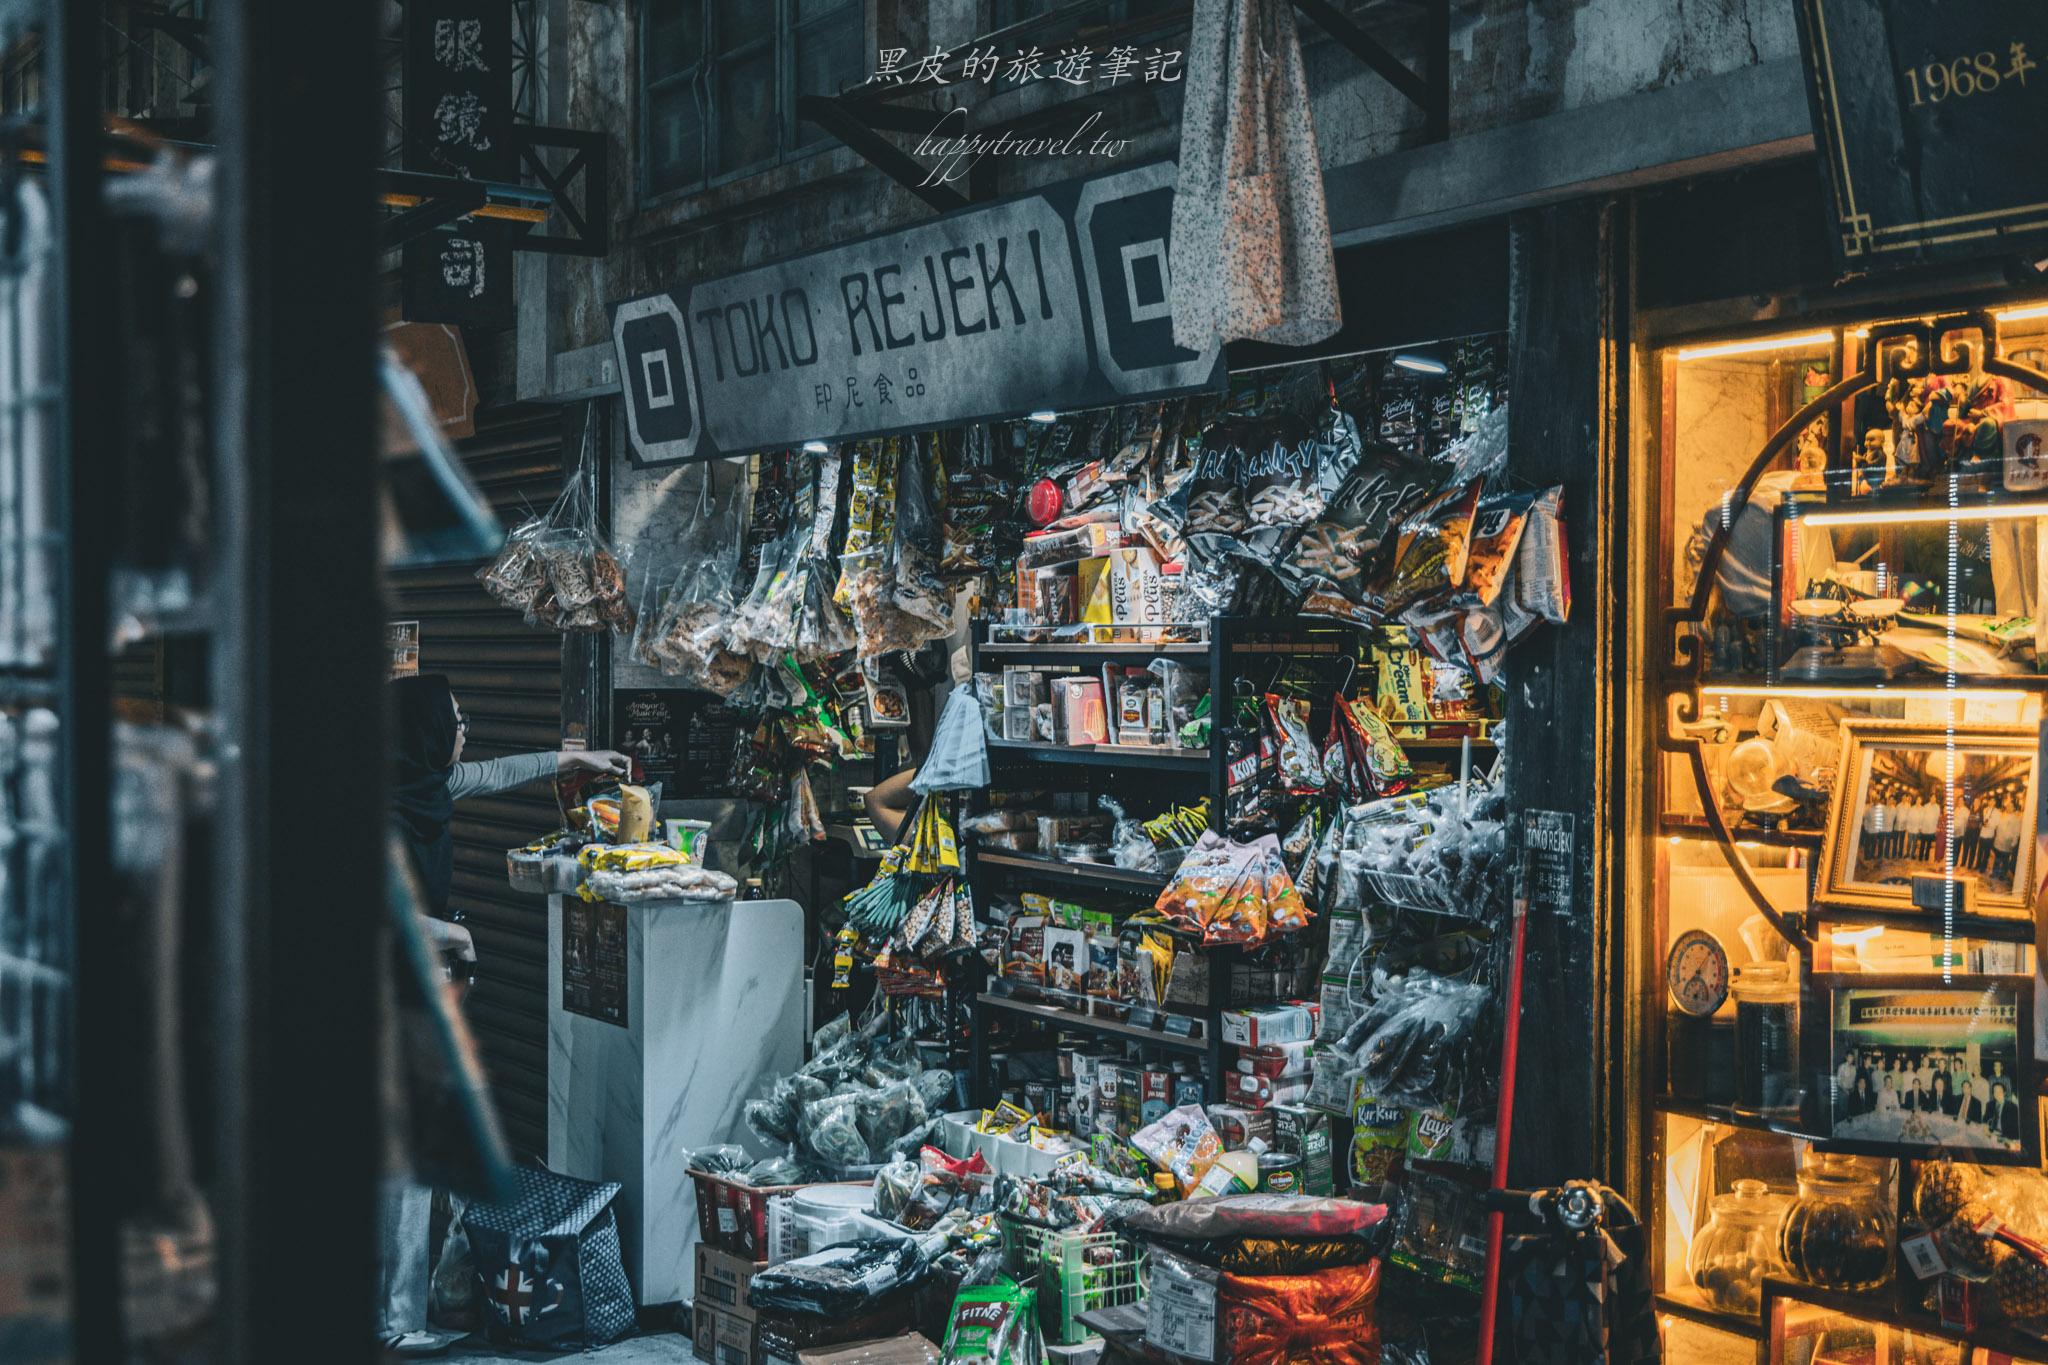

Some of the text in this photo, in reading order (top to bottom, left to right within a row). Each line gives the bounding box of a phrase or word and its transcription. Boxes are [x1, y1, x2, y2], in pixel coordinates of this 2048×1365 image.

[1903, 41, 2037, 108] 1968年
[434, 17, 491, 300] 眼鏡司
[696, 228, 1056, 384] TOKO REJEKI
[815, 367, 926, 414] 印尼食品
[1144, 575, 1160, 622] Plus
[961, 1306, 1002, 1321] FITNE
